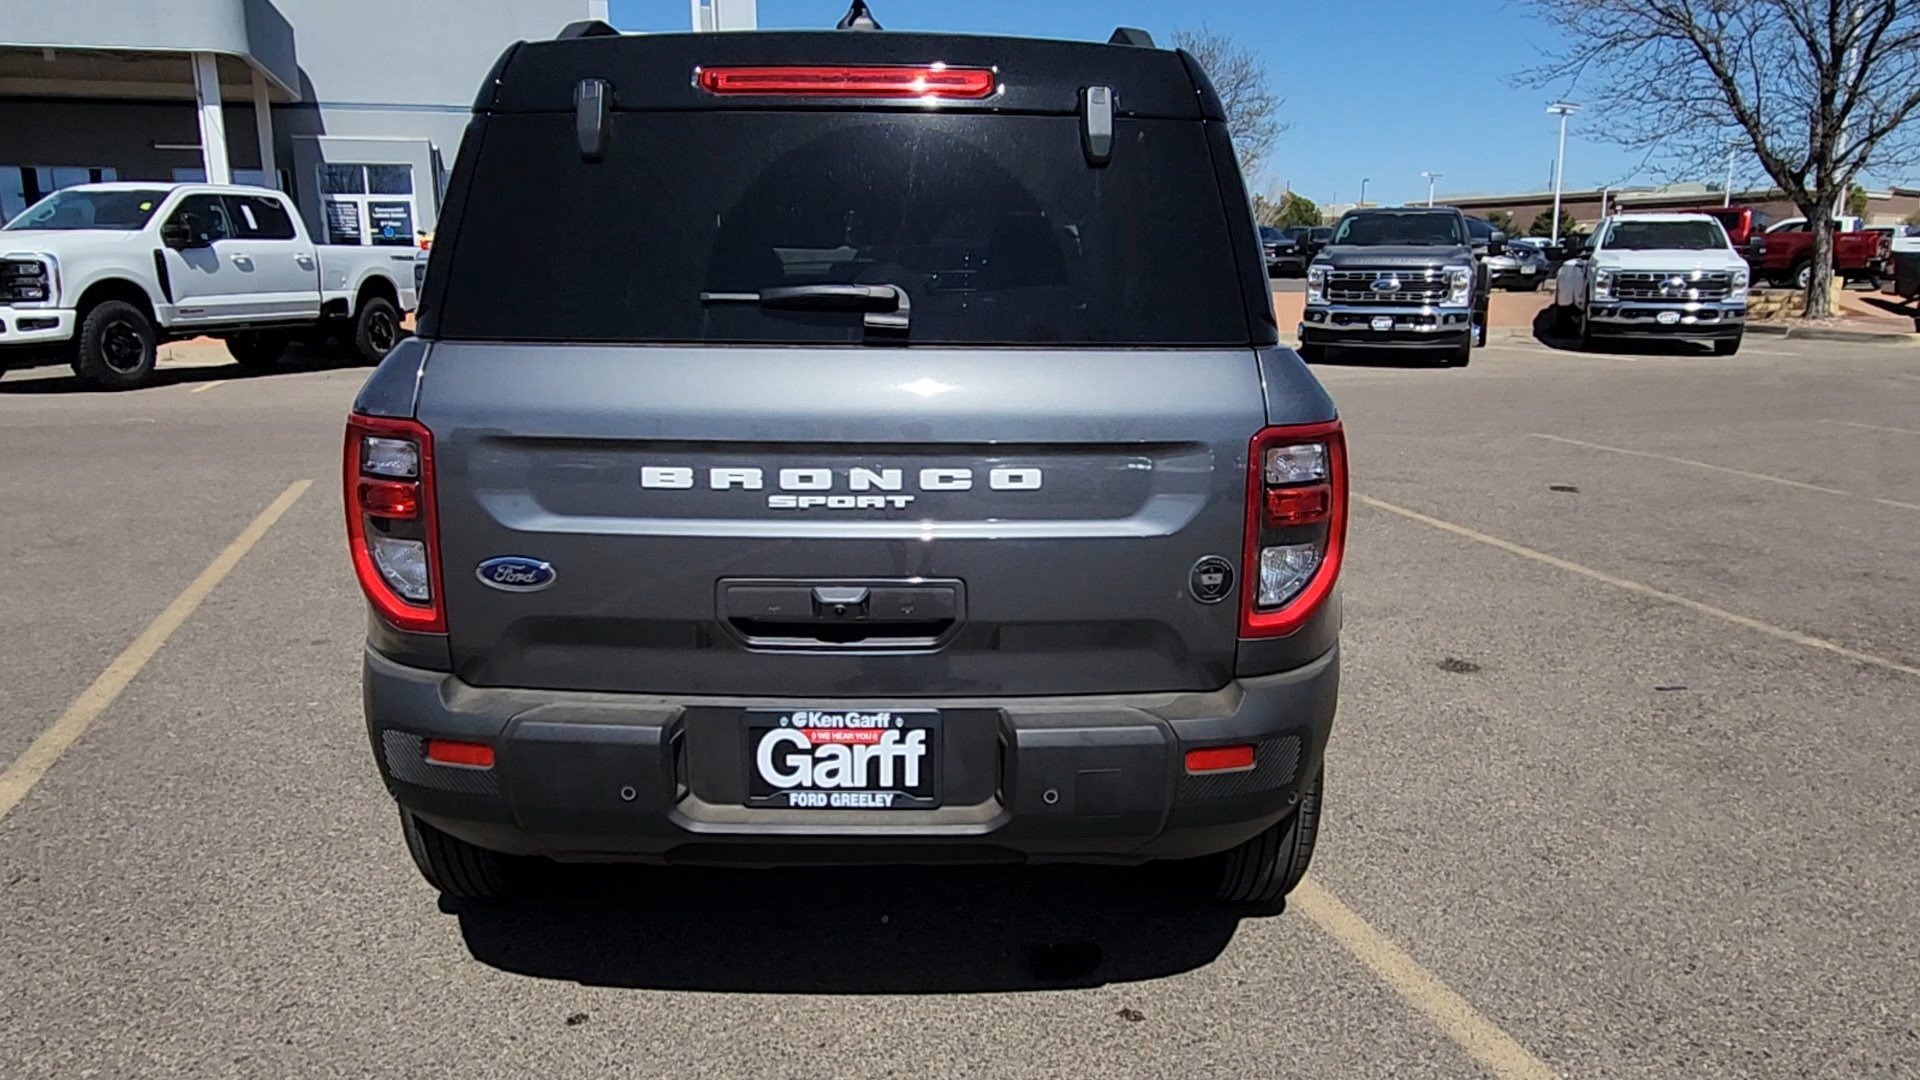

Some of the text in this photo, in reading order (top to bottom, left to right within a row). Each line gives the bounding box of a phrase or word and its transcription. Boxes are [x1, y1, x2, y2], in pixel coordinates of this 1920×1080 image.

[641, 466, 1042, 491] BRONCO
[768, 495, 915, 509] SPORT
[494, 564, 536, 582] Ford
[808, 712, 890, 728] Ken Garff
[817, 731, 872, 740] WE HEAR YOU
[756, 728, 926, 788] Garff
[789, 794, 893, 807] FORD GREELEY
